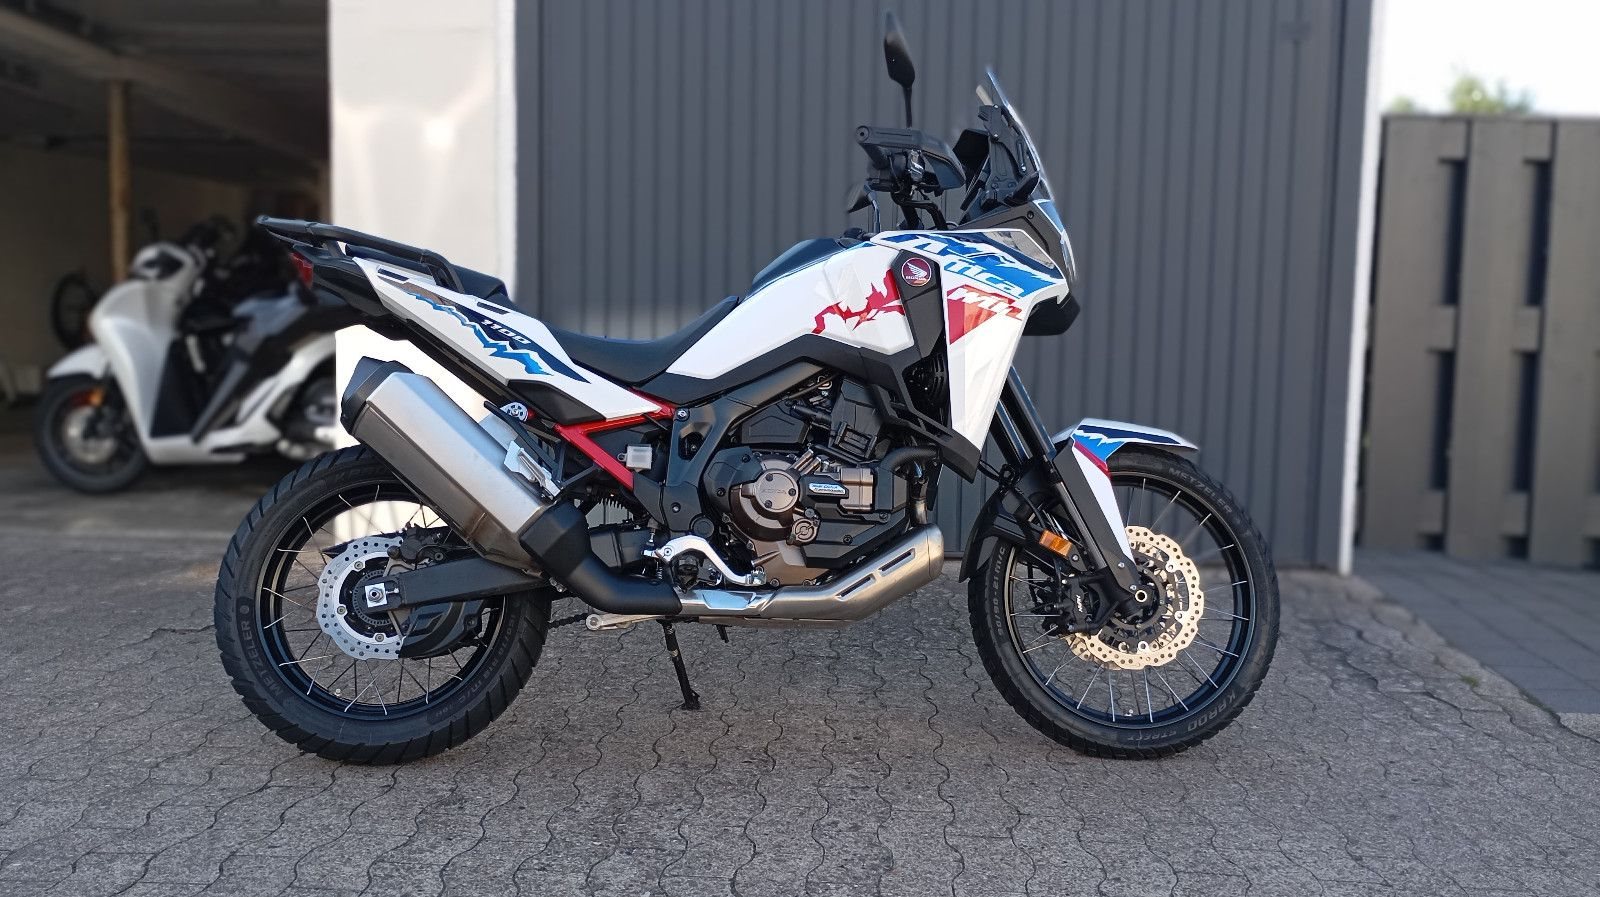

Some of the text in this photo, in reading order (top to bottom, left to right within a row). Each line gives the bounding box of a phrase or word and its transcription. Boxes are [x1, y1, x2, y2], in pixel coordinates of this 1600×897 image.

[481, 319, 531, 344] 1100
[1169, 467, 1233, 513] METZELER
[241, 620, 283, 697] METZELER
[1187, 689, 1236, 732] KAROO
